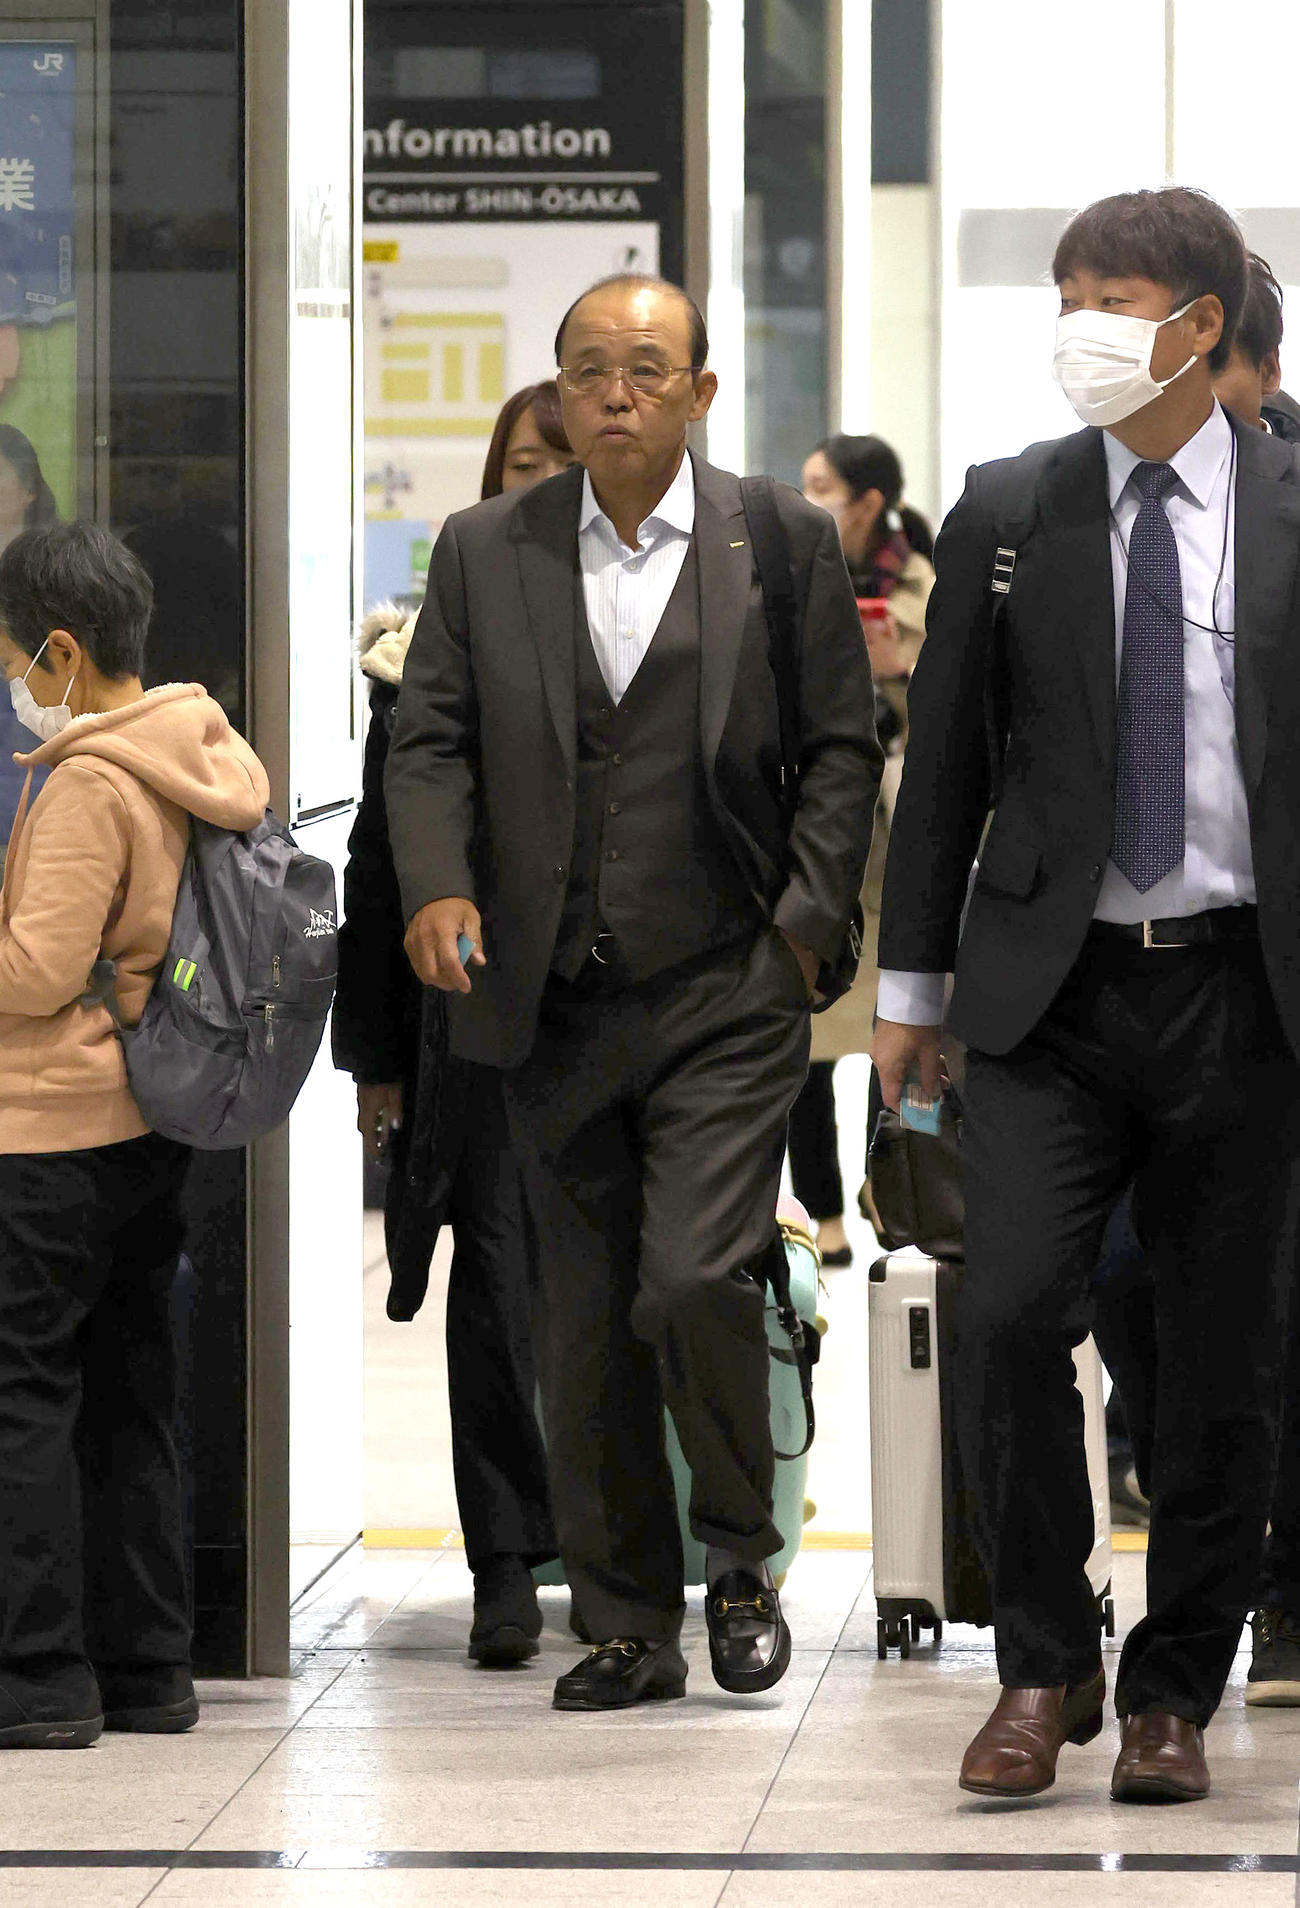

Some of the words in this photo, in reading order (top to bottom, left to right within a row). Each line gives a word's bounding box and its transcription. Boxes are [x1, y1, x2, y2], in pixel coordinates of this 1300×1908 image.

[33, 53, 63, 70] JR
[363, 119, 611, 157] nformation
[367, 188, 457, 213] Center
